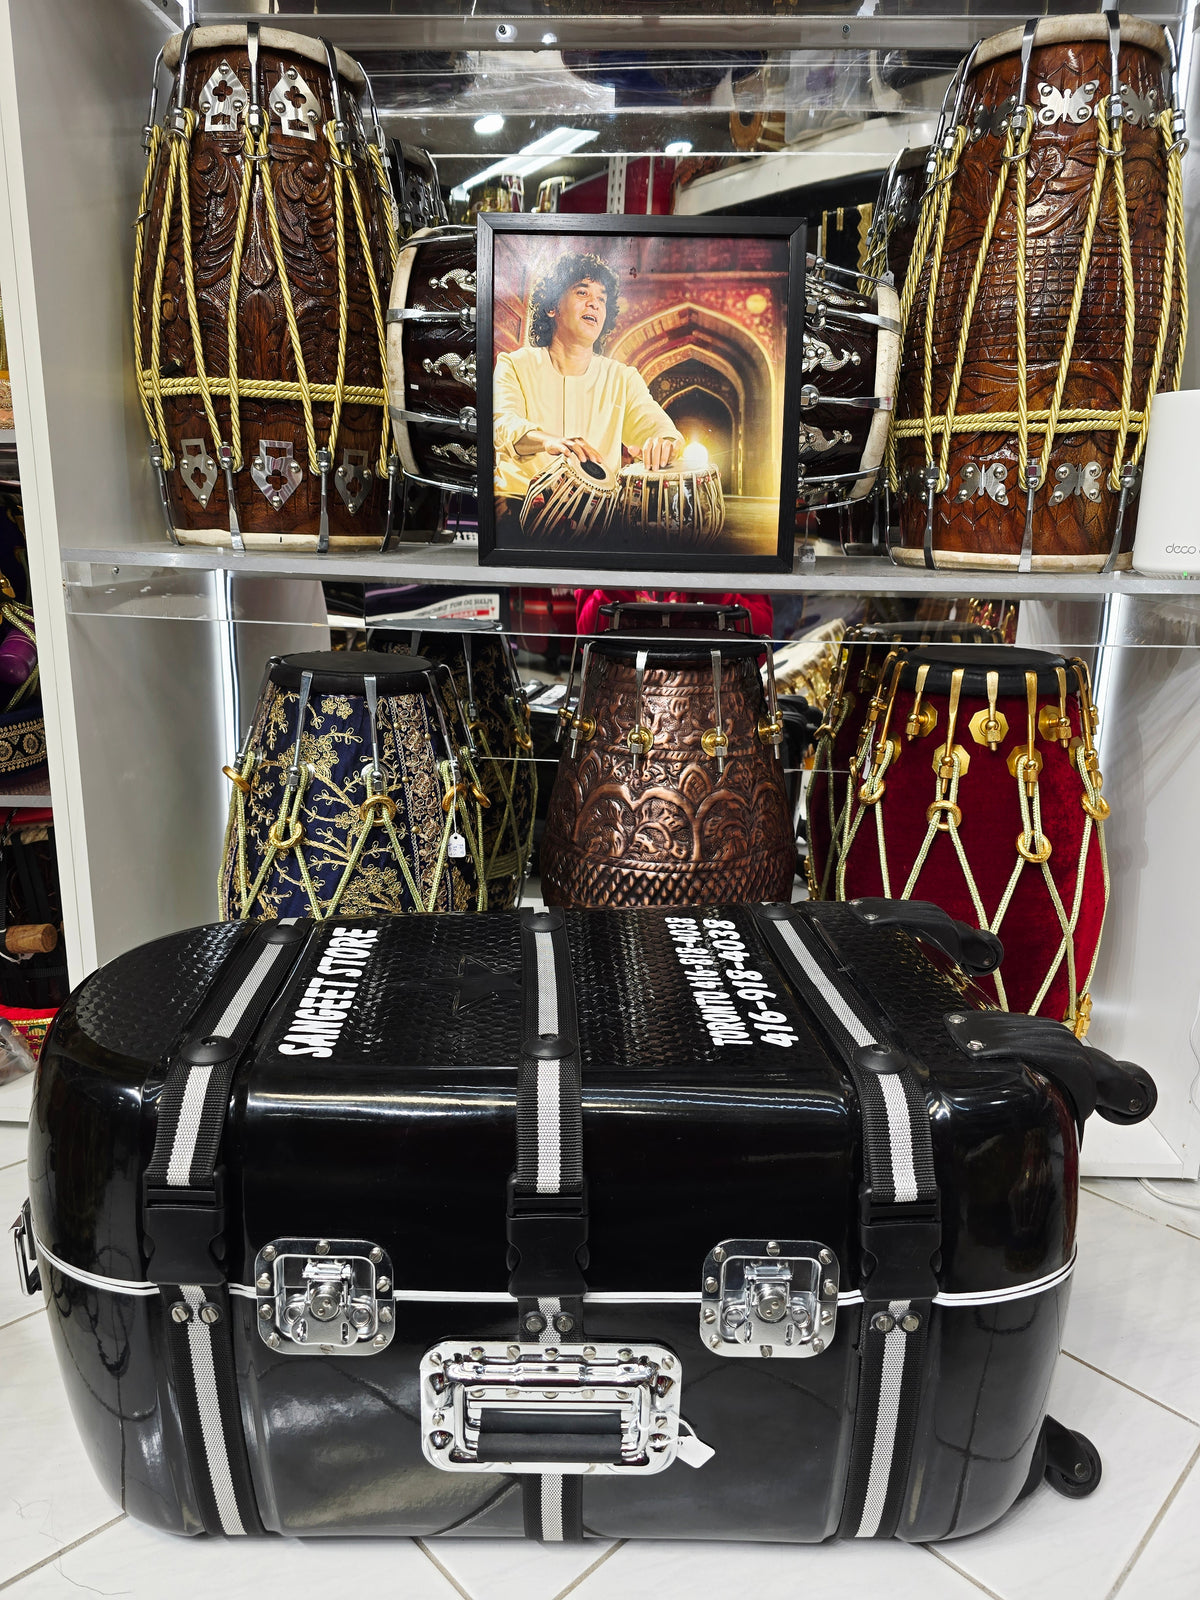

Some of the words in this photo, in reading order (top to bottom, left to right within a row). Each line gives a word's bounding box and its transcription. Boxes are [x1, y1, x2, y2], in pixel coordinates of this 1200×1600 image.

[1165, 543, 1197, 555] deco
[316, 927, 379, 978] STORE
[664, 917, 724, 989] 416-818-4038
[702, 918, 799, 1048] 416-918-4038
[278, 977, 359, 1058] SANGEET
[693, 990, 754, 1046] TORONTO
